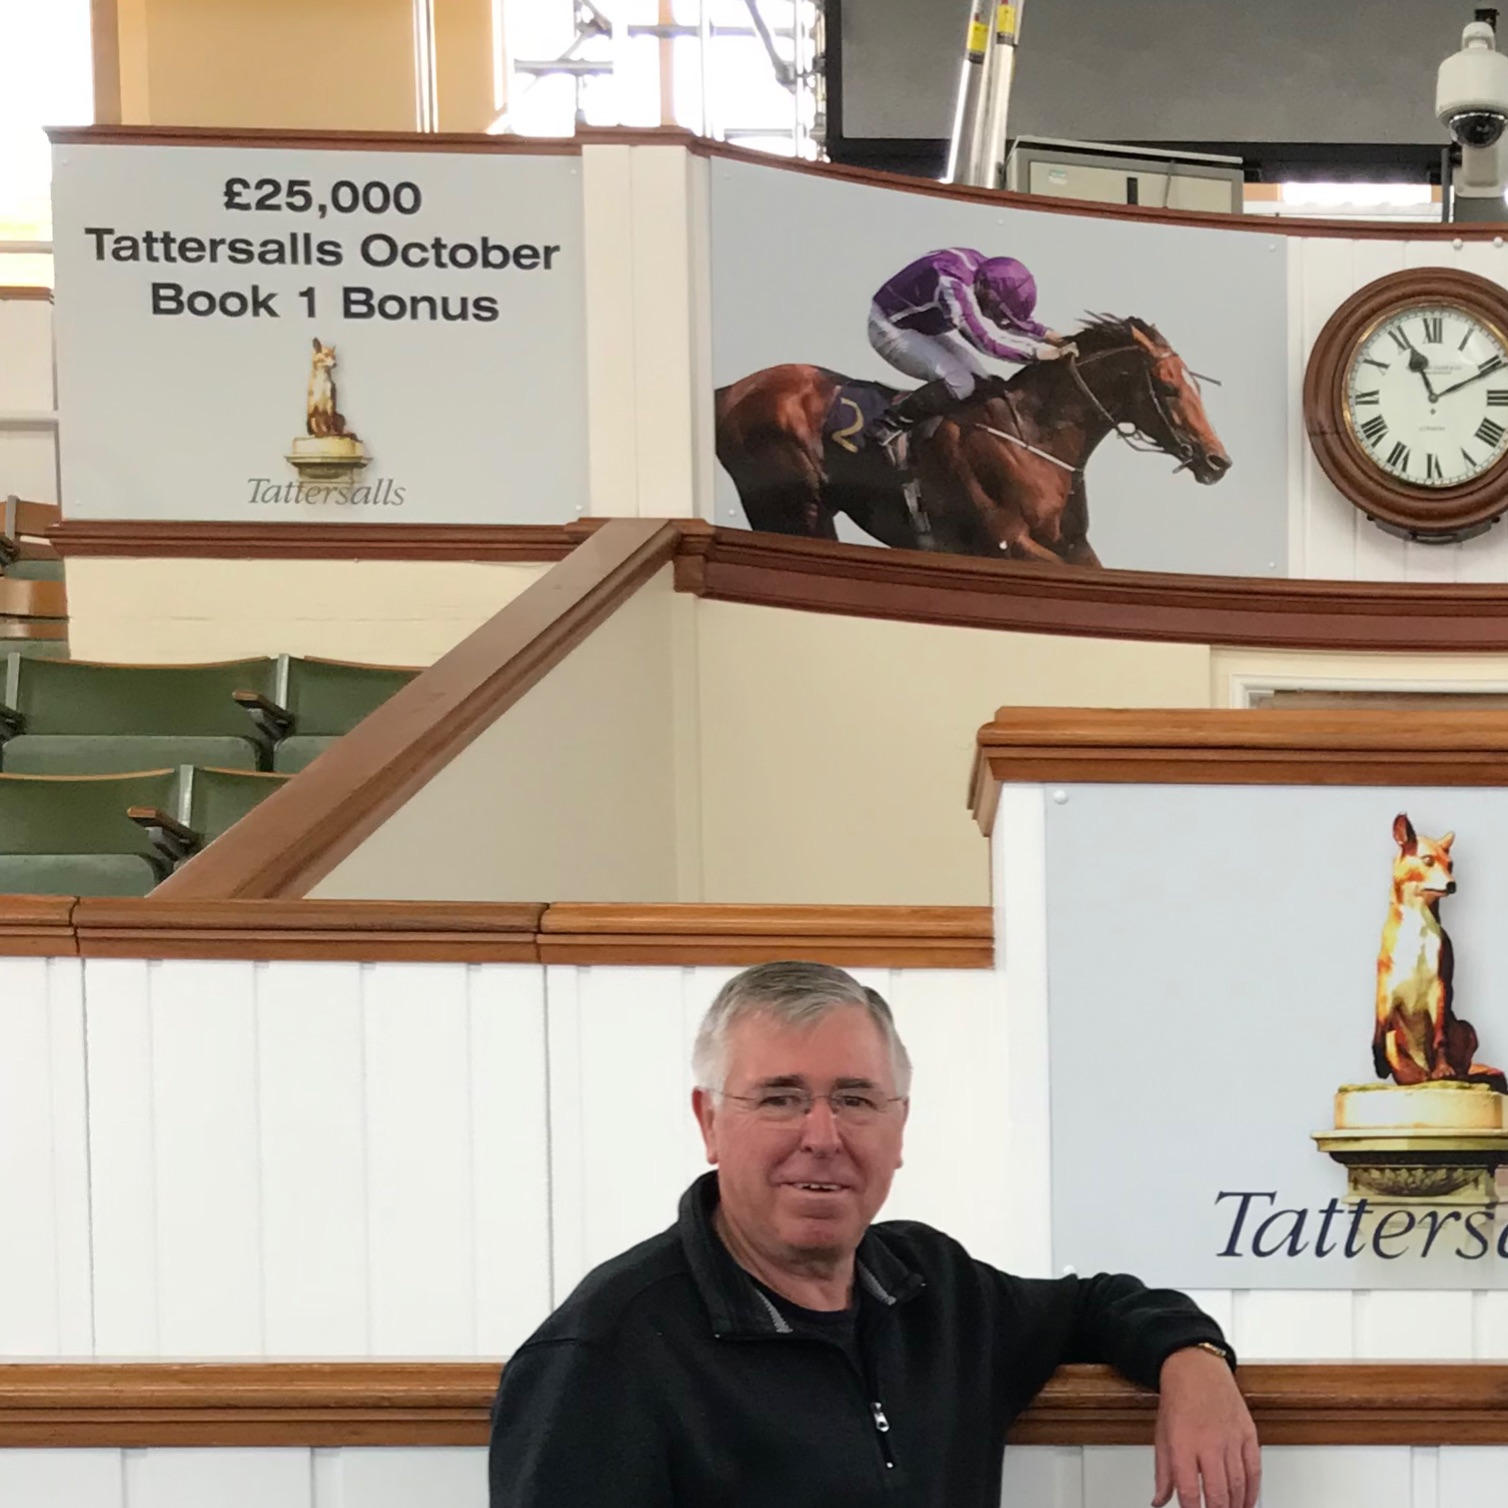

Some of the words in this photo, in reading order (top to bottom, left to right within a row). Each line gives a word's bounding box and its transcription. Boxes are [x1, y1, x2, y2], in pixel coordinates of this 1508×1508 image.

[223, 177, 423, 218] £25,000
[84, 227, 343, 266] Tattersalls
[360, 232, 561, 270] October
[151, 282, 280, 317] Book
[299, 286, 317, 318] 1
[342, 286, 500, 322] Bonus
[832, 397, 865, 454] 2
[247, 477, 407, 507] Tattersalls
